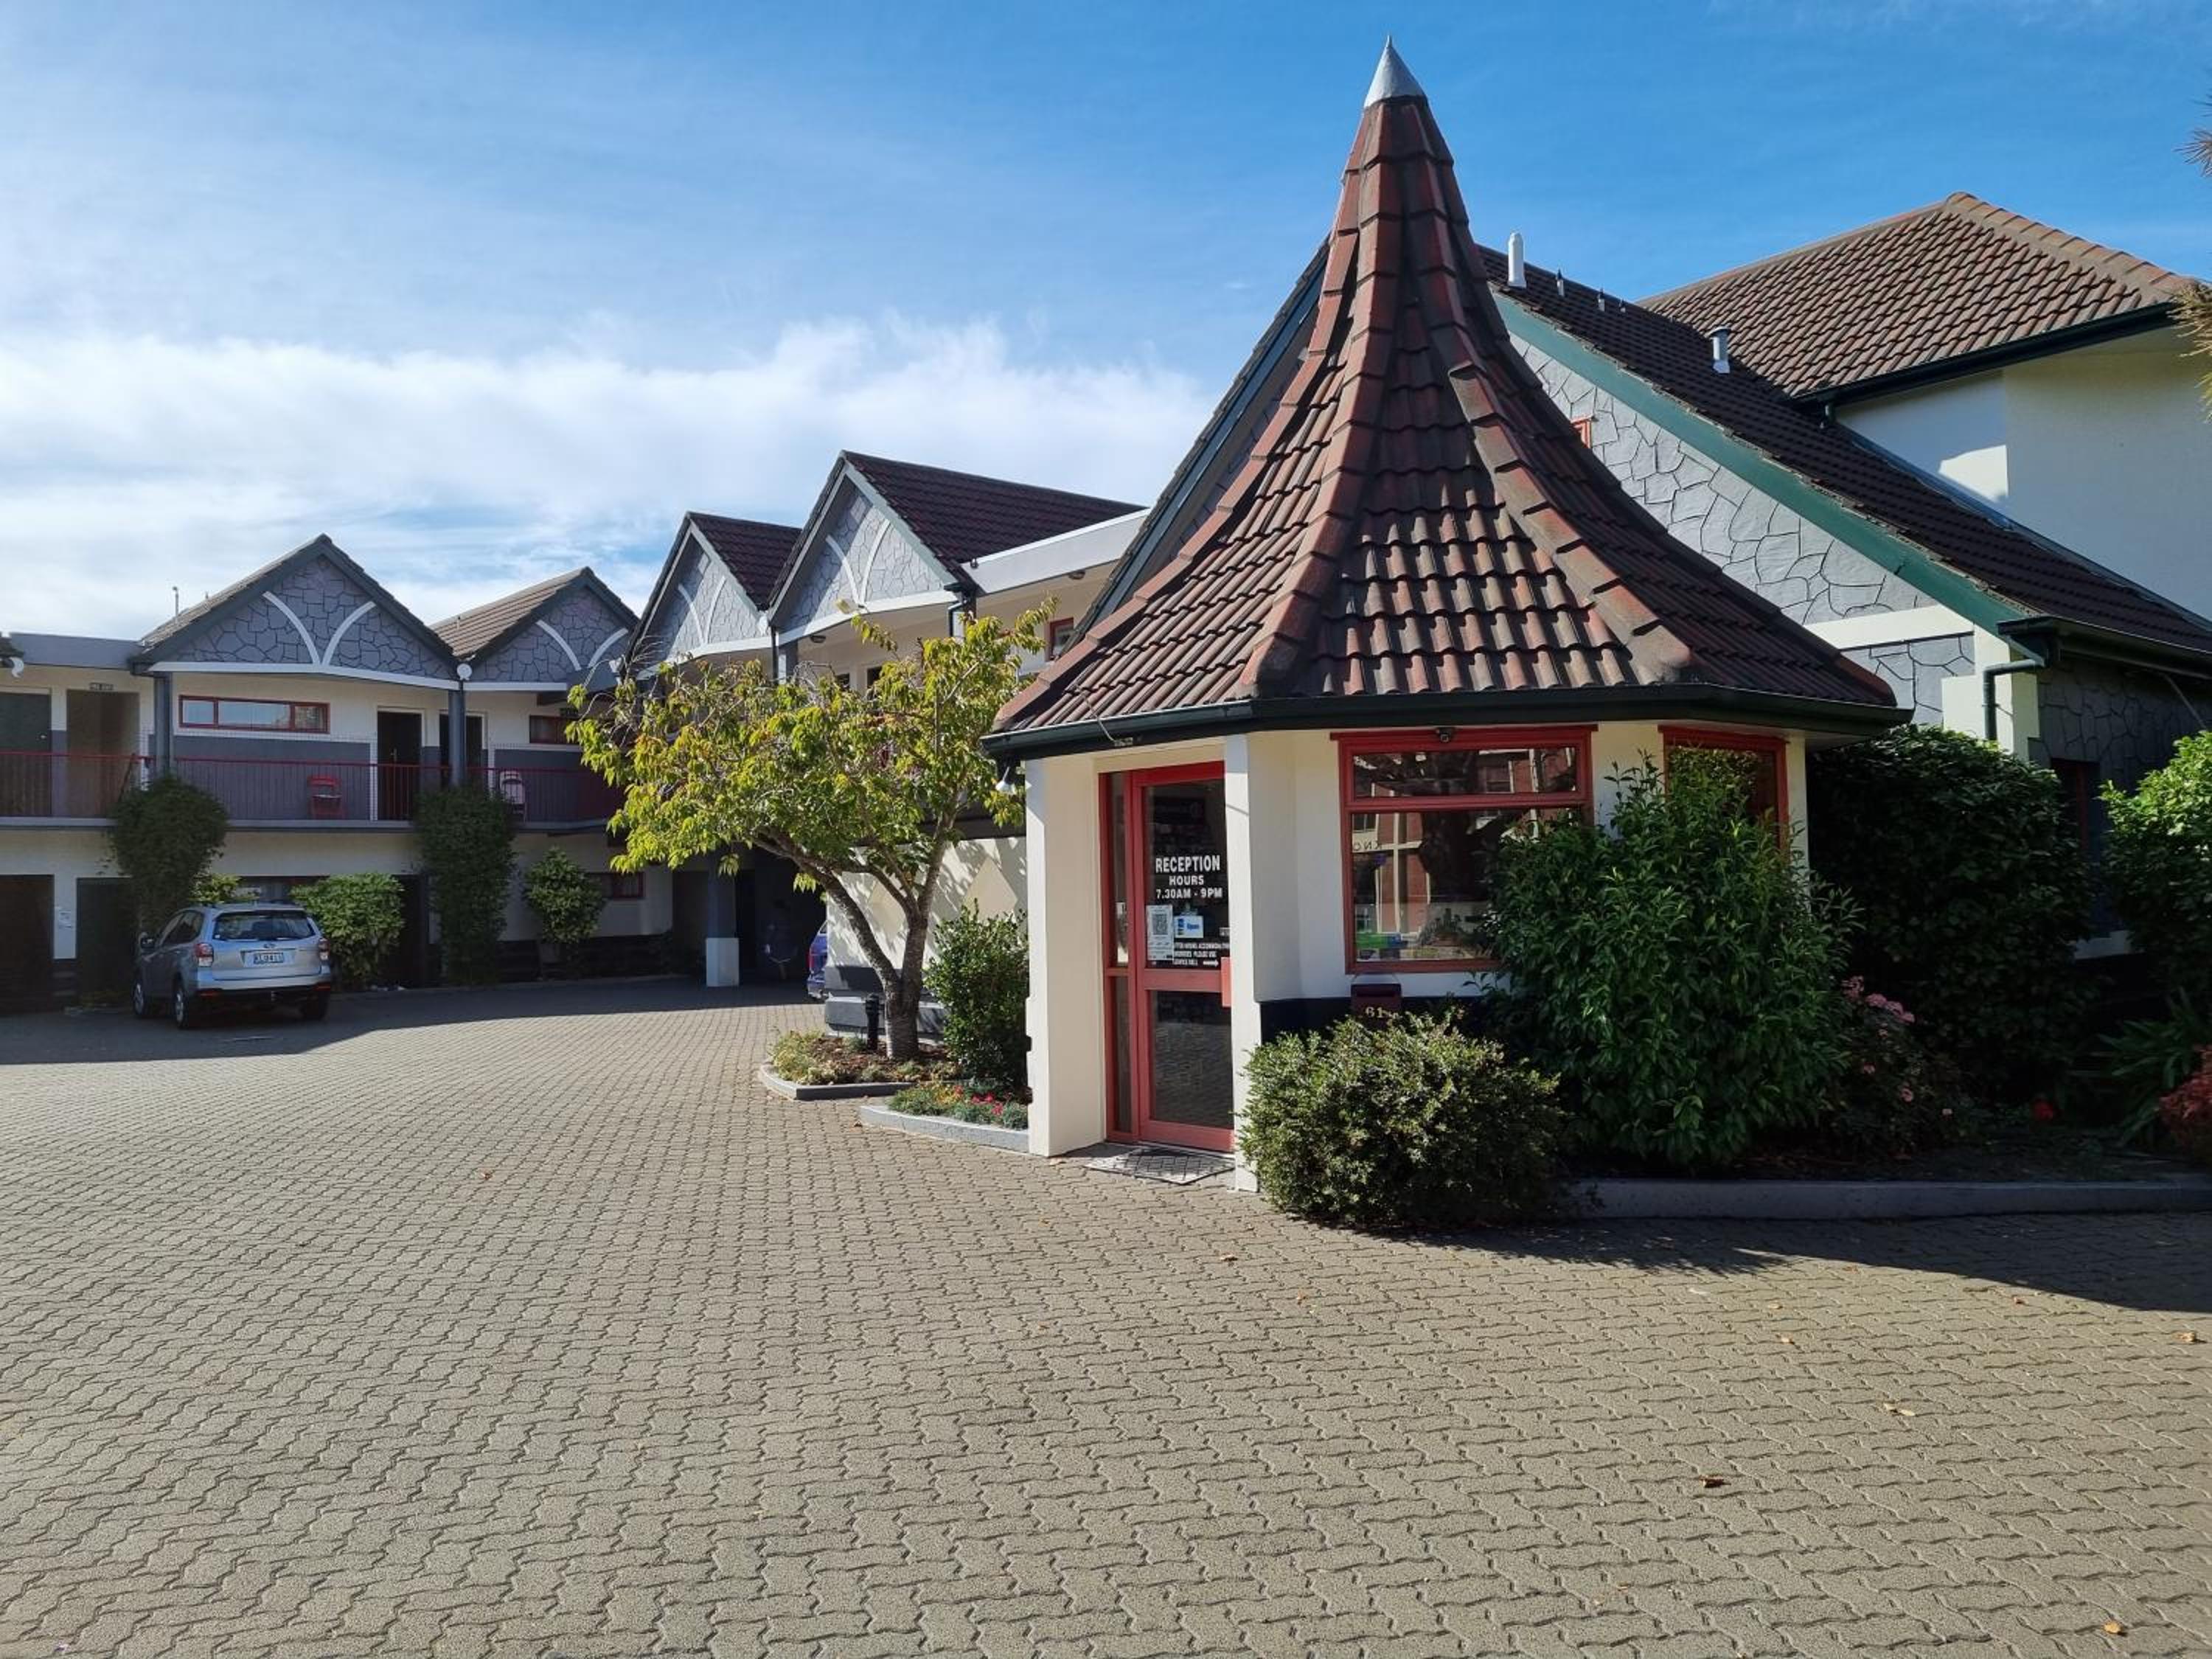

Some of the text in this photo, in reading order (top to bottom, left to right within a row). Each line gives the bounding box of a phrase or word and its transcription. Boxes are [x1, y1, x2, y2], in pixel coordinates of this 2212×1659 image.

[1155, 855, 1220, 873] RECEPTION
[1169, 874, 1204, 886] HOURS
[1156, 888, 1191, 899] 7.30AM
[1200, 887, 1222, 898] 9PM
